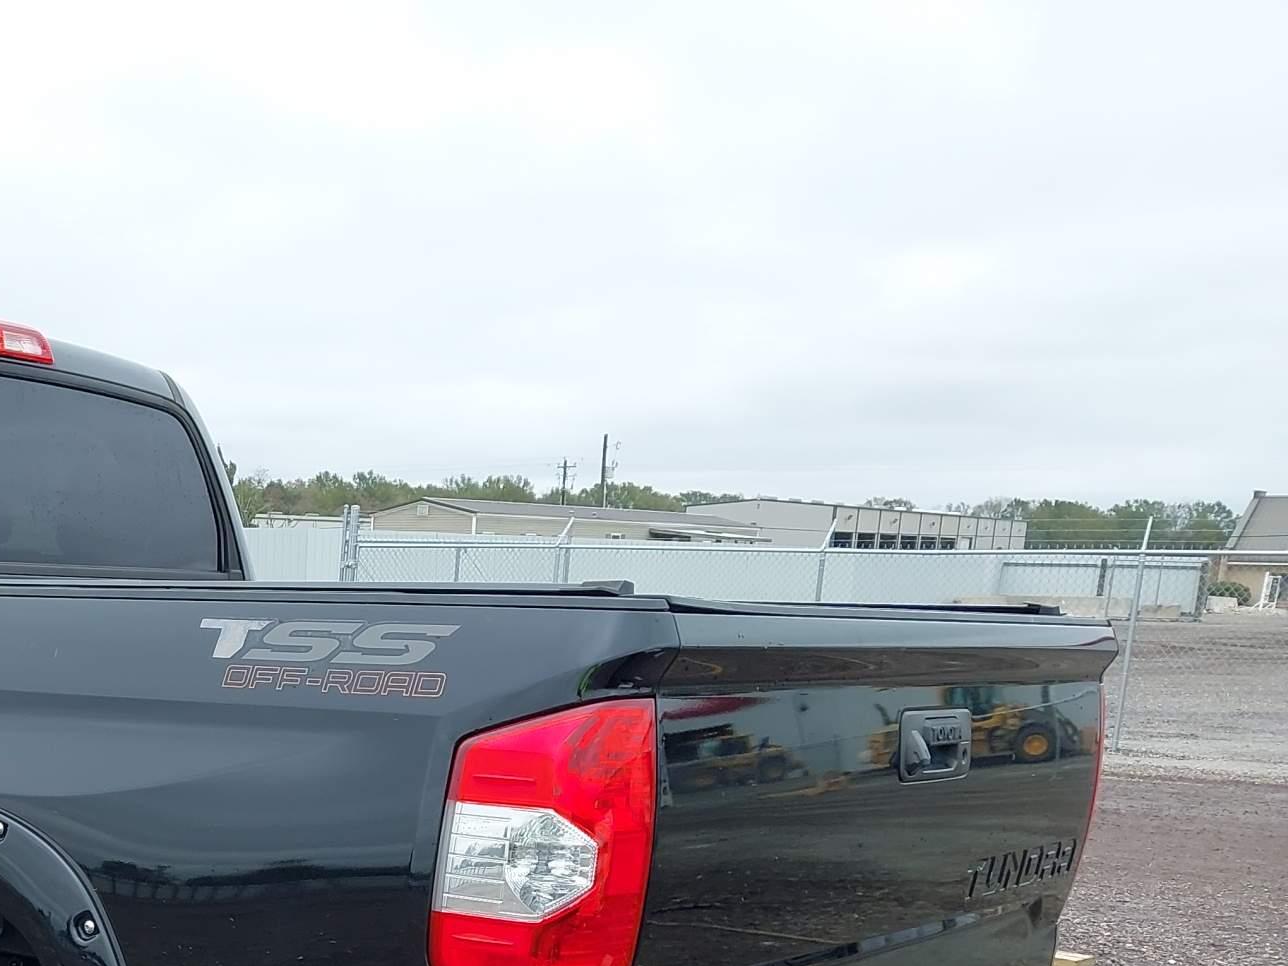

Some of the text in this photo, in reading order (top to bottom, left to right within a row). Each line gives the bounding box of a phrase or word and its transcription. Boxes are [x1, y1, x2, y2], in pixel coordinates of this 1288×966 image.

[199, 617, 463, 667] TSS
[222, 664, 447, 698] OFF-ROAD
[965, 839, 1077, 900] TUNDRA
